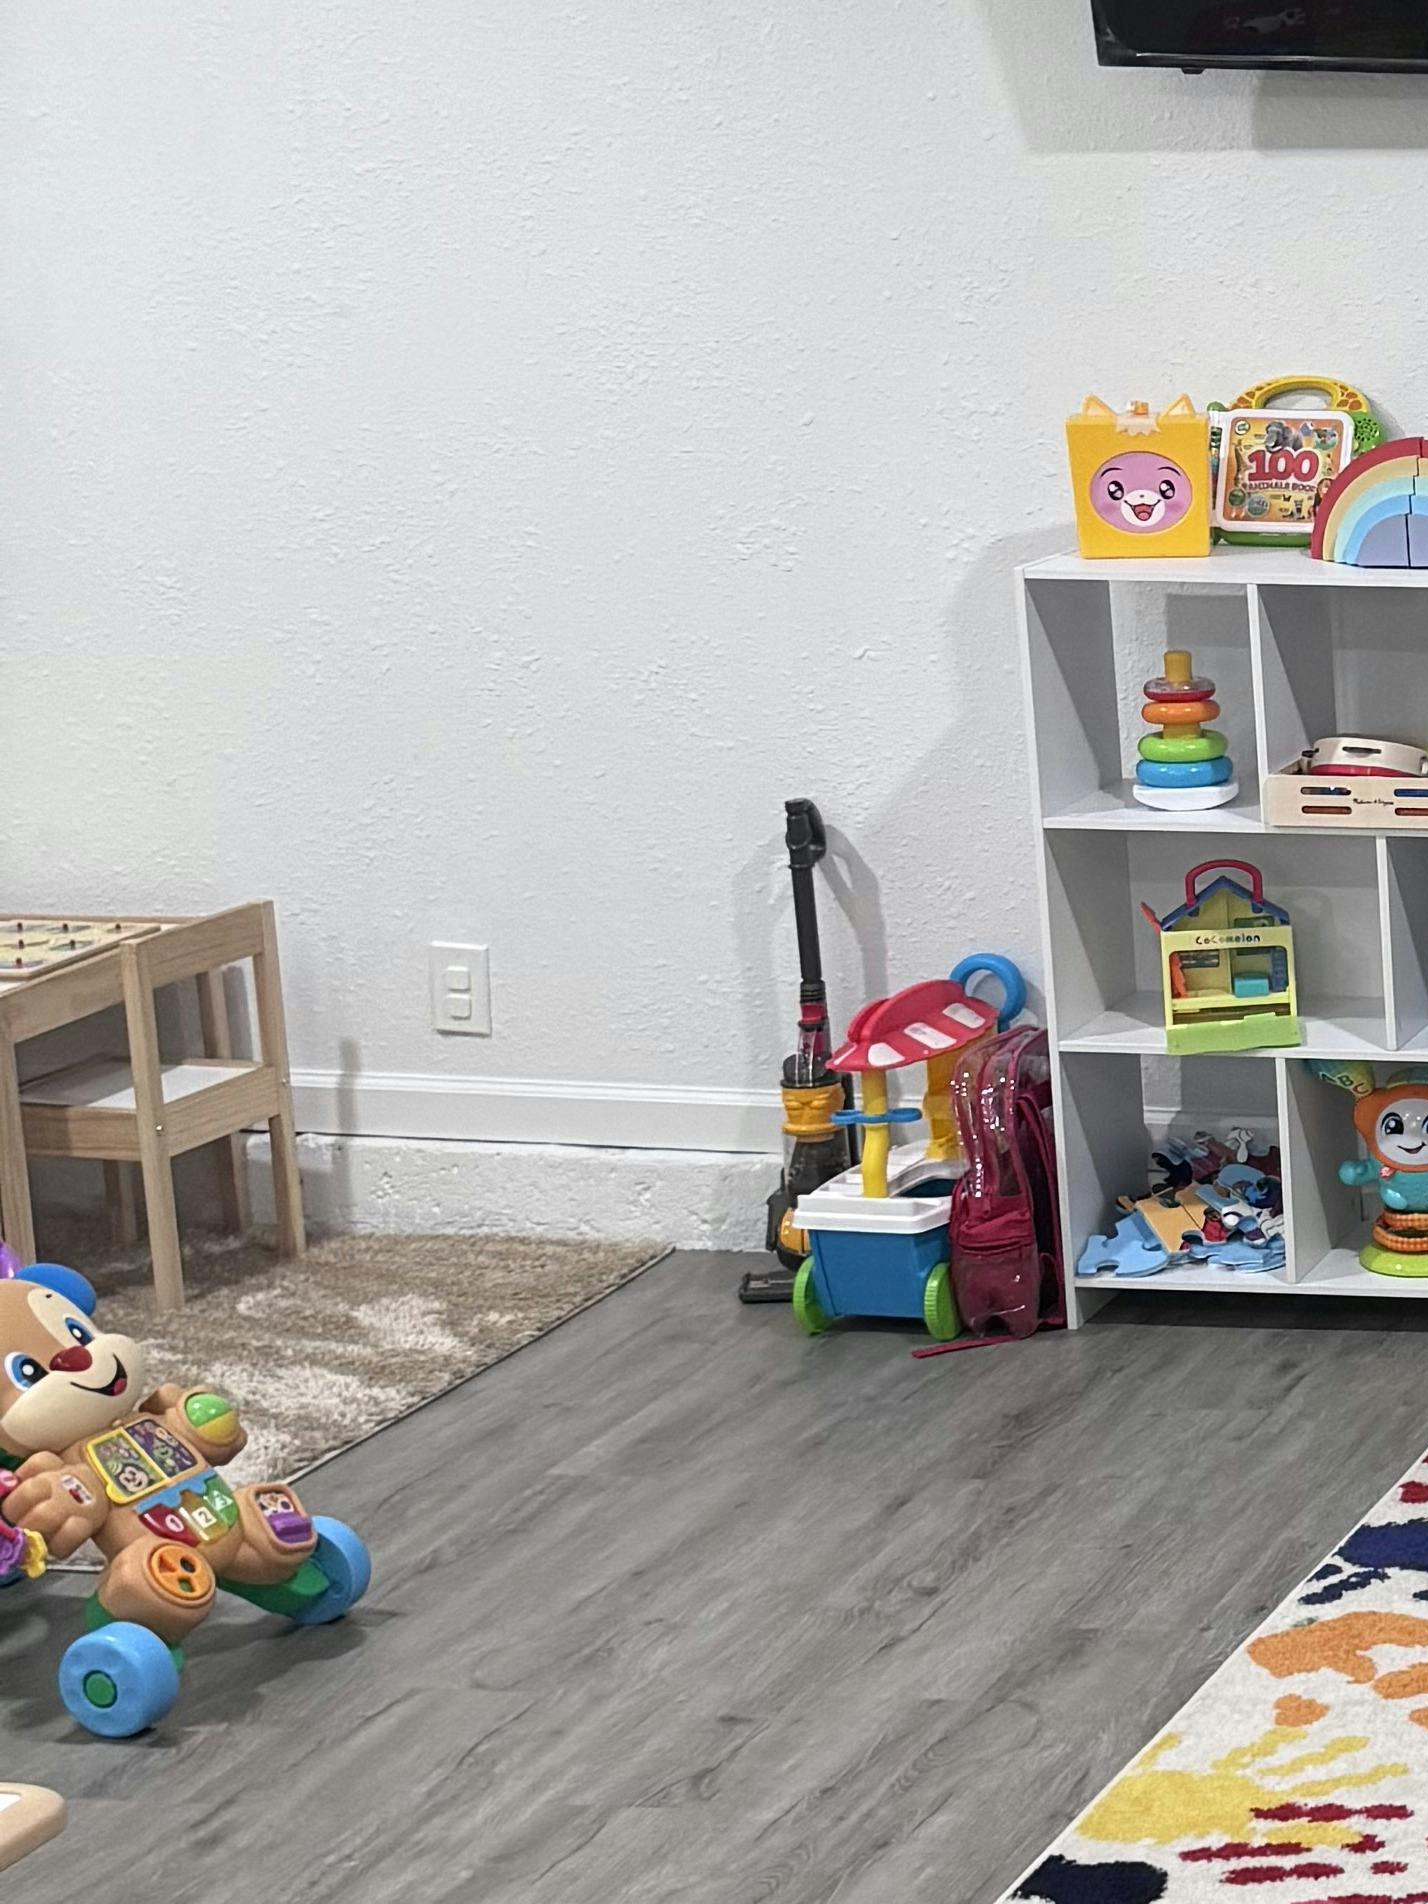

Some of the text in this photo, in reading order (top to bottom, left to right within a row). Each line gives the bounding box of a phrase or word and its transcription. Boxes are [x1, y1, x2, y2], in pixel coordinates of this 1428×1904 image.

[1247, 449, 1319, 482] 100
[170, 1516, 181, 1530] 1
[198, 1510, 212, 1523] 2
